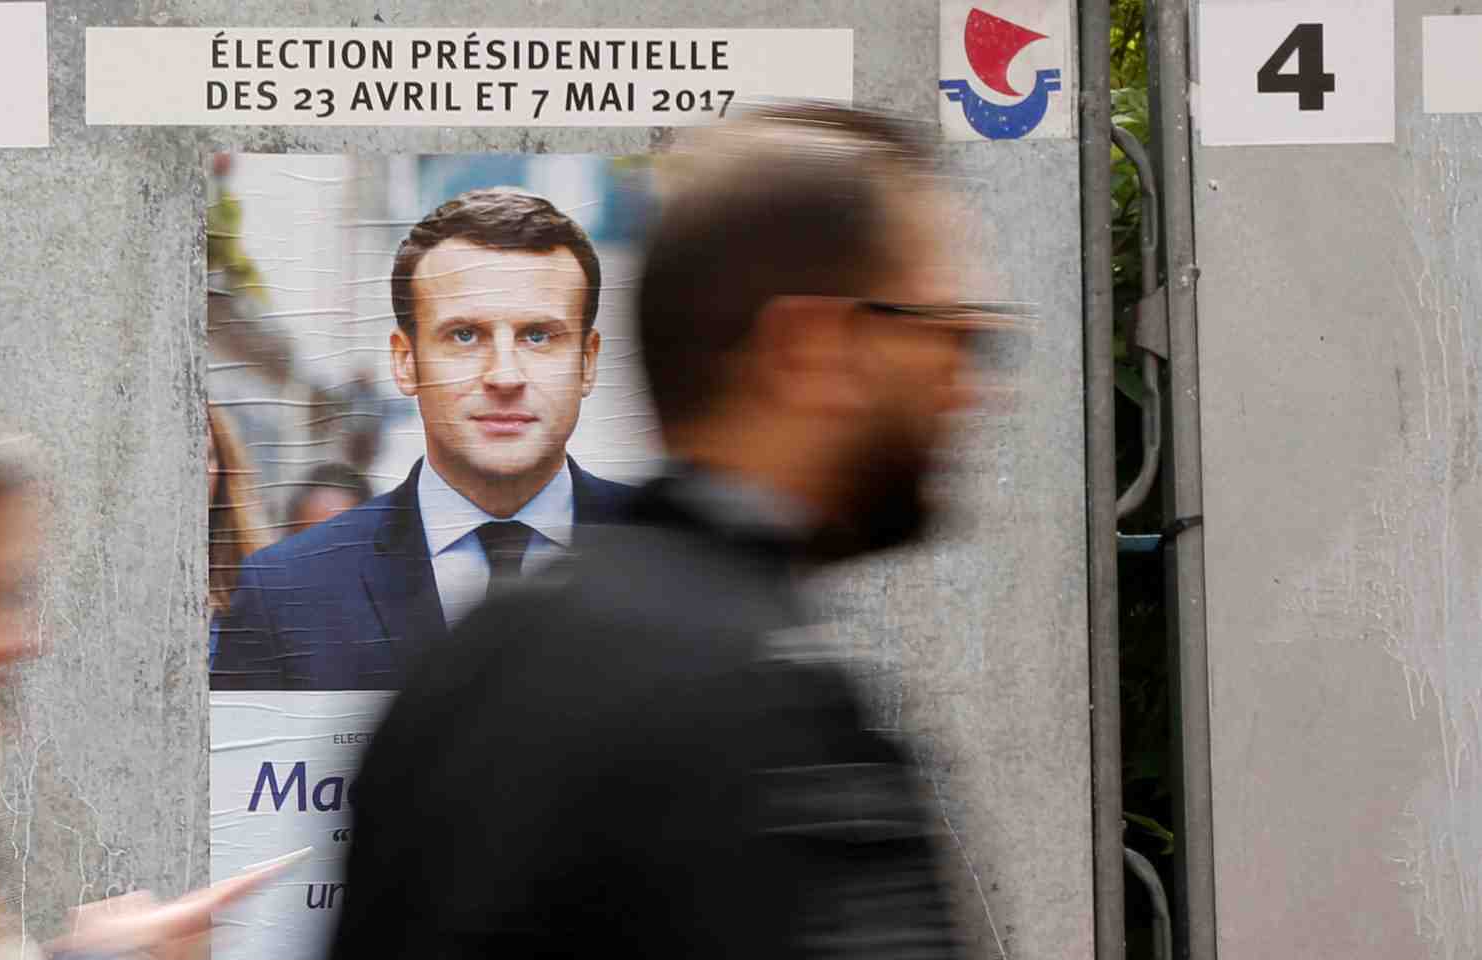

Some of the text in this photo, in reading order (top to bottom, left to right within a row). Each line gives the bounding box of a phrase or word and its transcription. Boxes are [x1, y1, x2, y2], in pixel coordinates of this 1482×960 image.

[211, 31, 729, 71] ÉLECTION PRÉSIDENTIELLE
[1257, 23, 1335, 111] 4
[206, 80, 736, 119] DES 23 AVRIL ET 7 MAI 2017
